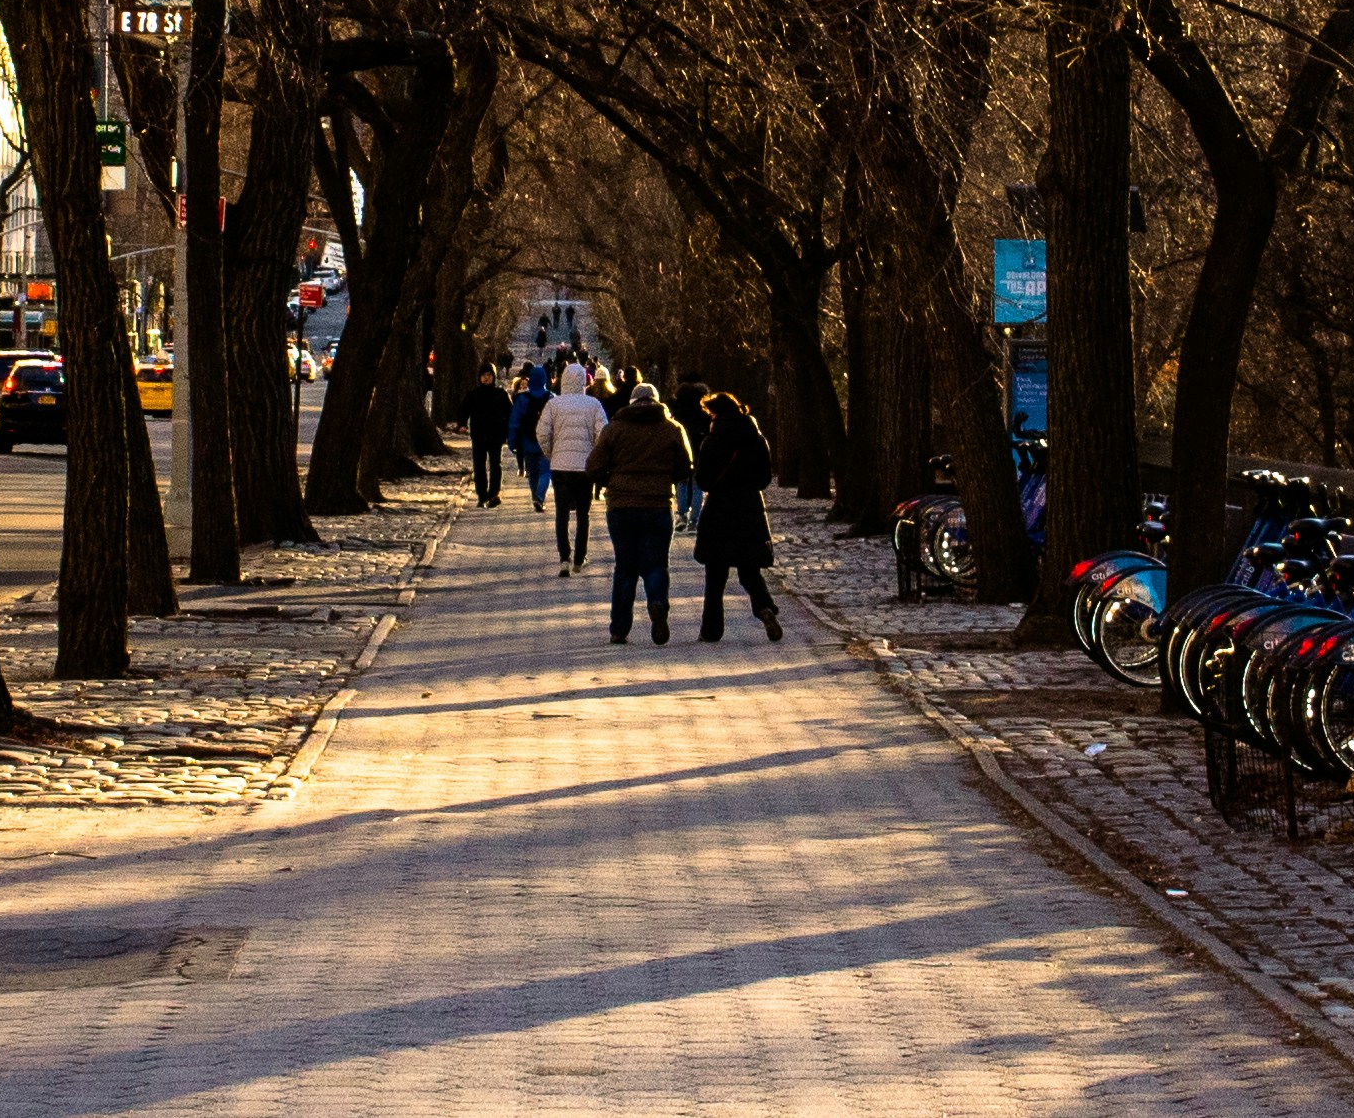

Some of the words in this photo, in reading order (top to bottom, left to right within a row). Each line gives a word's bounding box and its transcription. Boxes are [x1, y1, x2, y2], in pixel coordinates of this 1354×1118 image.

[121, 12, 131, 32] E
[137, 12, 158, 33] 78
[164, 12, 182, 33] St
